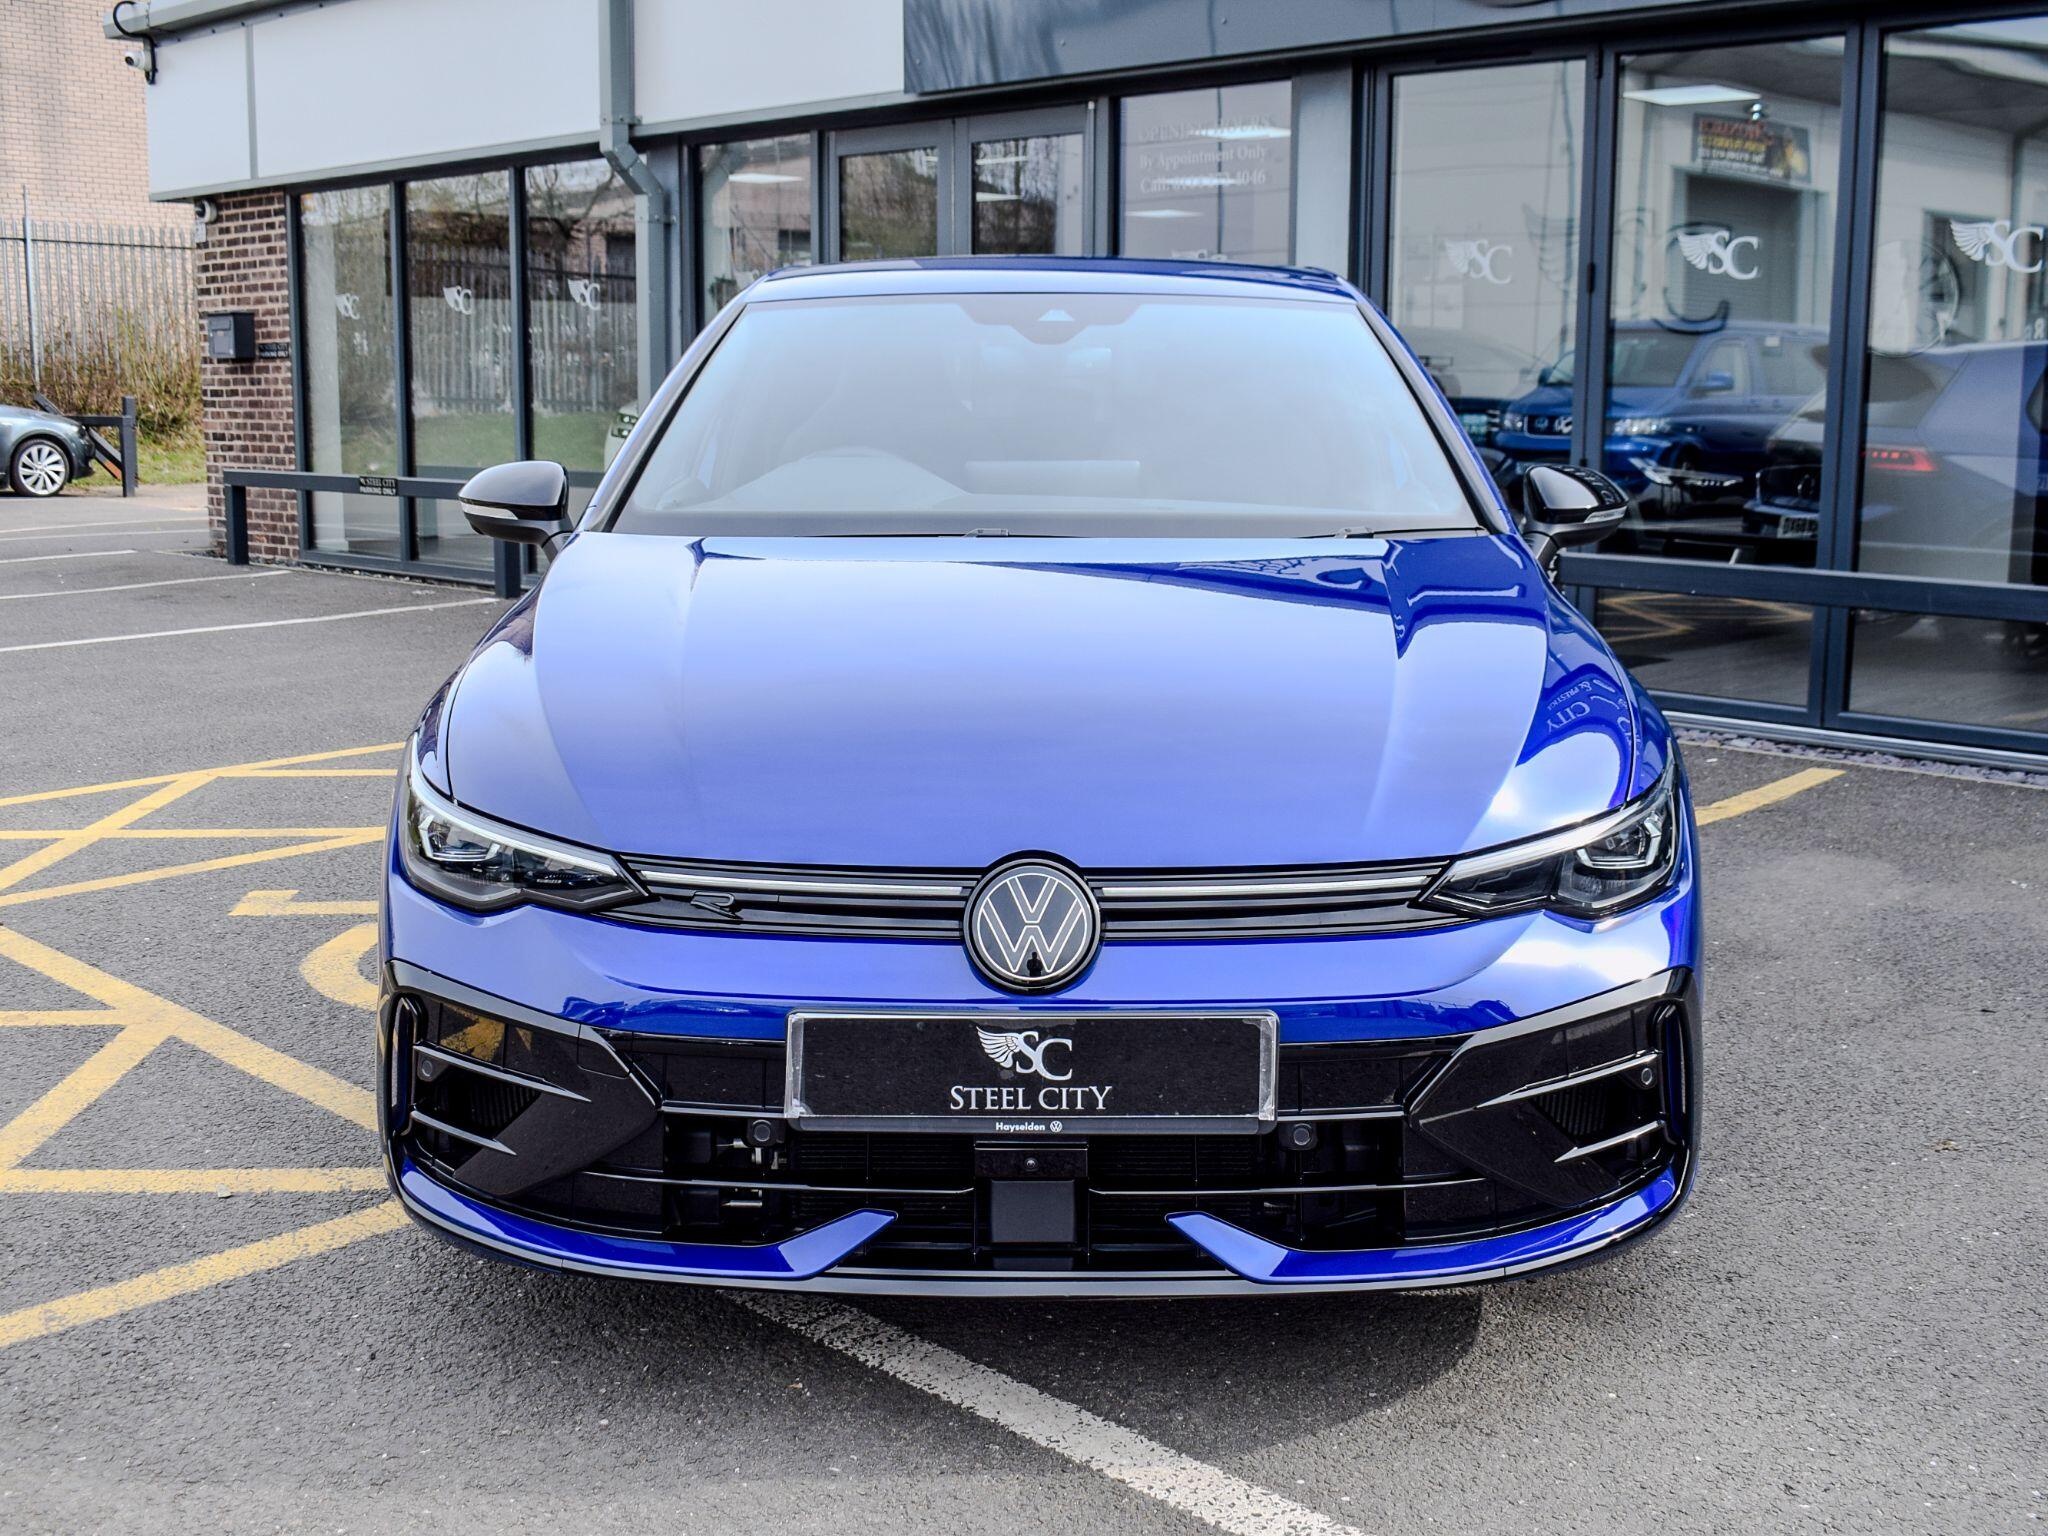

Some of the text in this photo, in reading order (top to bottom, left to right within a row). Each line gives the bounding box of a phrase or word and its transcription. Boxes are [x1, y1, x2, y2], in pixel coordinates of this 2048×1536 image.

[1159, 145, 1235, 172] Appointment
[1236, 141, 1267, 163] Only
[1708, 230, 1759, 280] SC
[1015, 1031, 1073, 1081] SC
[950, 1085, 1113, 1110] STEEL CITY
[995, 1121, 1046, 1133] Hayselden
